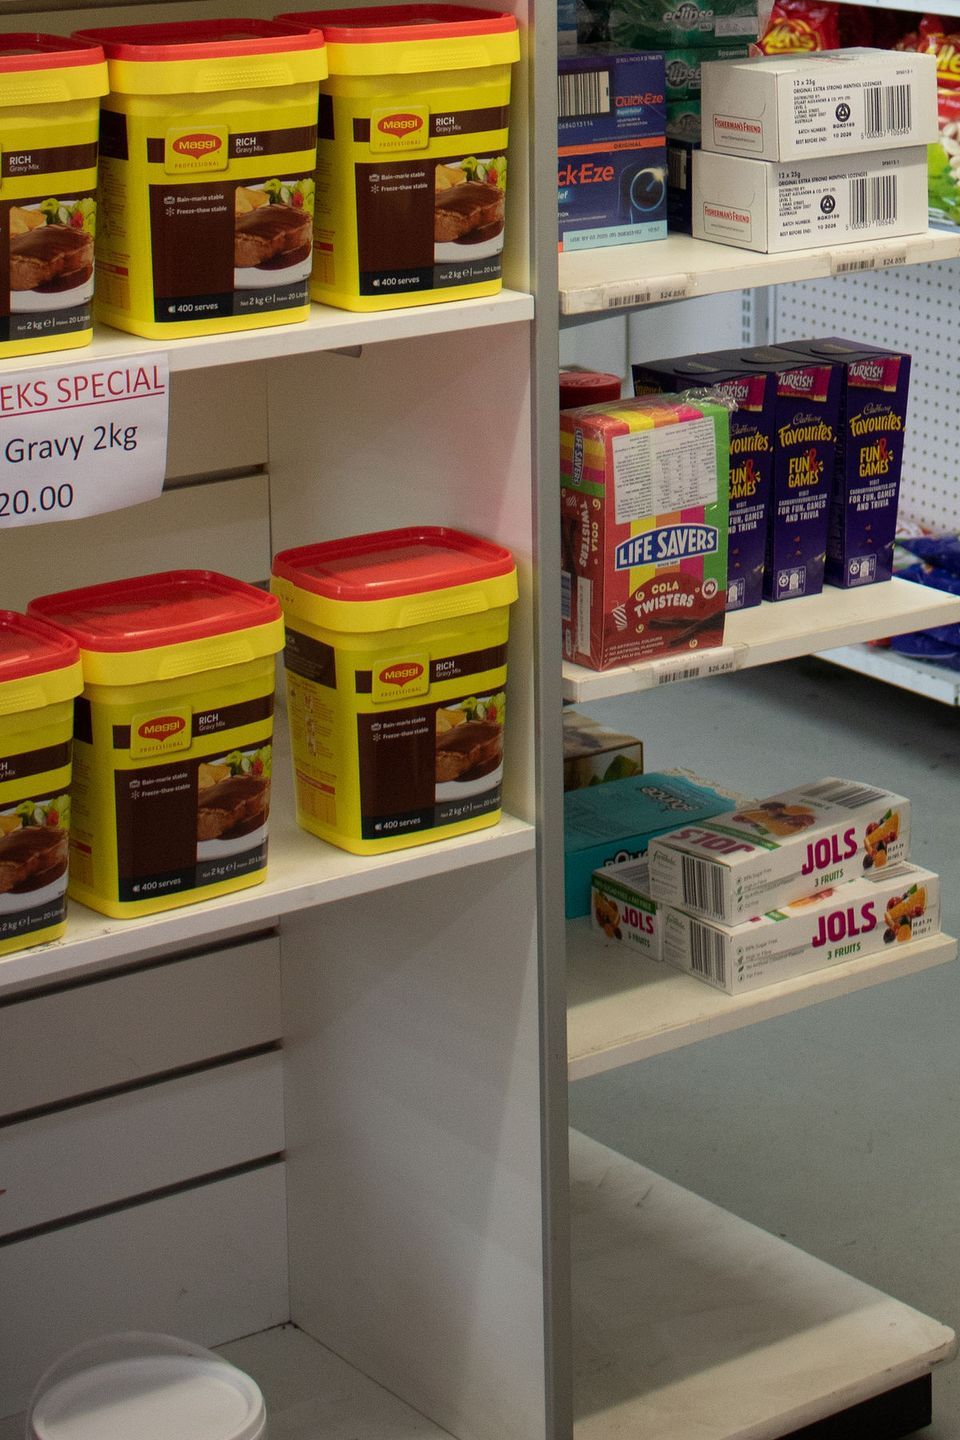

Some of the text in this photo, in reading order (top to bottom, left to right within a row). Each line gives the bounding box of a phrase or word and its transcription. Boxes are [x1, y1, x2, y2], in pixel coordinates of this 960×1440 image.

[384, 119, 418, 131] Maggi
[435, 116, 456, 127] RICH
[435, 125, 452, 134] Gravy
[179, 139, 217, 152] Maggi
[235, 136, 258, 148] RICH
[235, 144, 264, 155] Gravy Mix
[381, 275, 420, 286] 400 serves
[177, 302, 219, 313] 400 serves
[849, 361, 884, 379] TURKISH
[57, 365, 165, 403] SPECIAL
[778, 371, 814, 390] TURKISH
[849, 411, 902, 438] Favourites
[5, 422, 138, 464] Gravy 2kg
[778, 420, 832, 448] Favourites
[860, 445, 880, 463] FUN
[789, 455, 810, 474] FUN
[859, 459, 889, 477] GAMES
[788, 470, 819, 488] GAMES
[849, 493, 862, 504] FOR
[877, 489, 896, 499] GAMES
[857, 499, 889, 512] AND TRIVIA
[578, 500, 591, 569] TWISTERS
[591, 521, 599, 553] COLA
[619, 526, 715, 566] LIFE SAVERS
[651, 580, 680, 595] COLA
[633, 593, 695, 618] TWISTERS
[384, 667, 419, 682] Maggi
[435, 660, 456, 672] RICH
[145, 720, 181, 735] Maggi
[383, 816, 421, 829] 400 serves
[801, 827, 858, 877] JOLS
[814, 868, 844, 888] 3 FRUITS
[622, 906, 655, 936] JOLS
[811, 901, 878, 949] JOLS
[827, 942, 862, 961] 3 FRUITS
